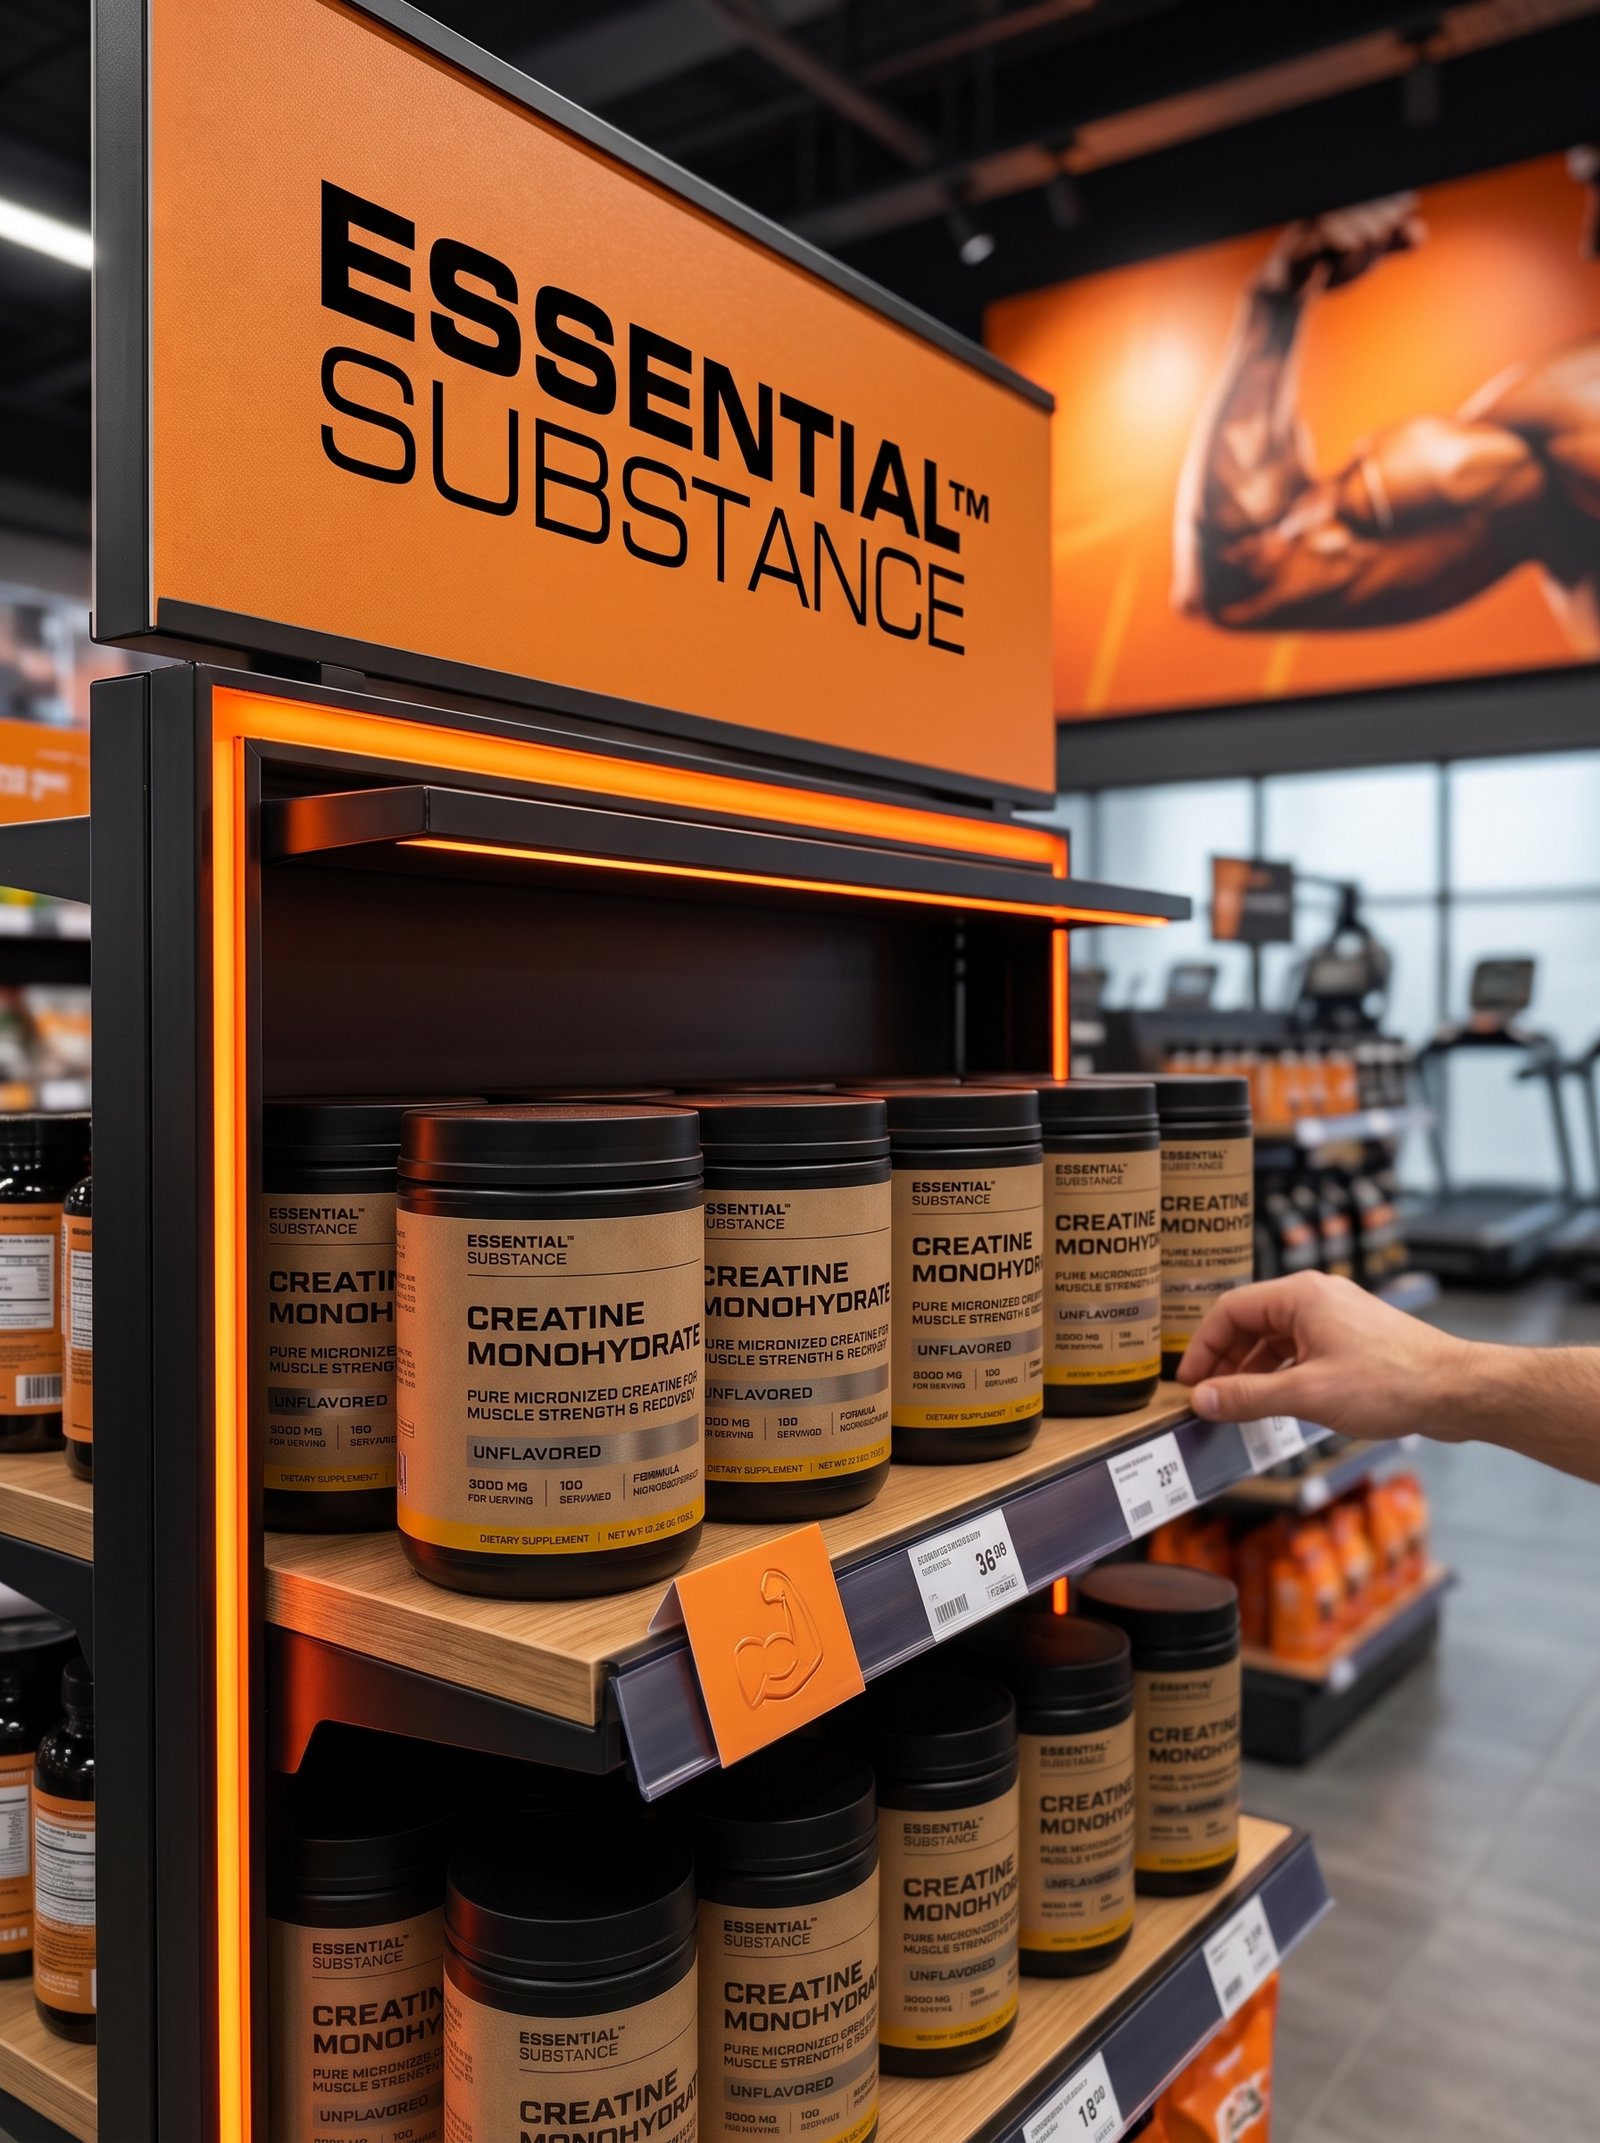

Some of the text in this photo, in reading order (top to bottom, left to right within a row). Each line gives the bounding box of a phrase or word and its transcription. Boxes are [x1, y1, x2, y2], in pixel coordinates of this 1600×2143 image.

[321, 346, 965, 656] SUBSTANCE
[912, 1195, 990, 1206] SUBSTANCE
[1160, 1193, 1249, 1212] CREATINE
[704, 1203, 790, 1215] SSENTIAL™
[704, 1218, 785, 1230] UBSTANCE
[1055, 1209, 1156, 1231] CREATINE
[269, 1223, 357, 1235] SUBSTANCE
[912, 1231, 1032, 1256] CREATINE
[467, 1251, 567, 1266] SUBSTANCE
[704, 1281, 890, 1318] MONOHYDRATE
[912, 1301, 948, 1311] PURE
[467, 1301, 645, 1332] CREATINE
[912, 1315, 966, 1325] MUSCLE
[1058, 1306, 1139, 1320] UNFLAVORED
[467, 1322, 700, 1367] MONOHYDRATE
[704, 1338, 734, 1350] URE
[738, 1337, 827, 1351] MICRONIZED
[830, 1330, 877, 1347] CREATINE
[917, 1340, 1012, 1356] UNFLAVORED
[270, 1346, 306, 1358] PURE
[704, 1352, 755, 1365] USCLE
[759, 1351, 833, 1365] STRENGTH
[270, 1361, 397, 1374] MUSCLE STRENG
[467, 1389, 510, 1404] PURE
[514, 1388, 618, 1404] MICRONIZED
[622, 1376, 682, 1399] CREATINE
[274, 1395, 387, 1408] UNFLAVORED
[467, 1407, 534, 1421] MUSCLE
[539, 1404, 625, 1421] STRENGTH
[473, 1445, 601, 1461] UNFLAVORED
[707, 1465, 804, 1475] DIETARY SUPPLEMENT
[507, 1481, 528, 1492] MG
[560, 1480, 583, 1490] 100
[480, 1533, 590, 1545] DIETARY SUPPLEMENT
[607, 1531, 625, 1541] NET
[903, 1831, 979, 1848] SUBSTANCE
[903, 1852, 1014, 1898] CREATINE
[723, 1932, 811, 1949] SUBSTANCE
[312, 1950, 403, 1970] SUBSTANCE
[909, 1957, 996, 1981] UNFLAVORED
[723, 1960, 863, 2006] CREATINE
[724, 2032, 839, 2056] PURE MICRONIZED
[519, 2043, 619, 2063] SUBSTANCE
[724, 2056, 778, 2069] MUSCLE
[313, 2068, 349, 2080] PURE
[313, 2082, 369, 2093] MUSCLE
[519, 2067, 678, 2126] CREATINE
